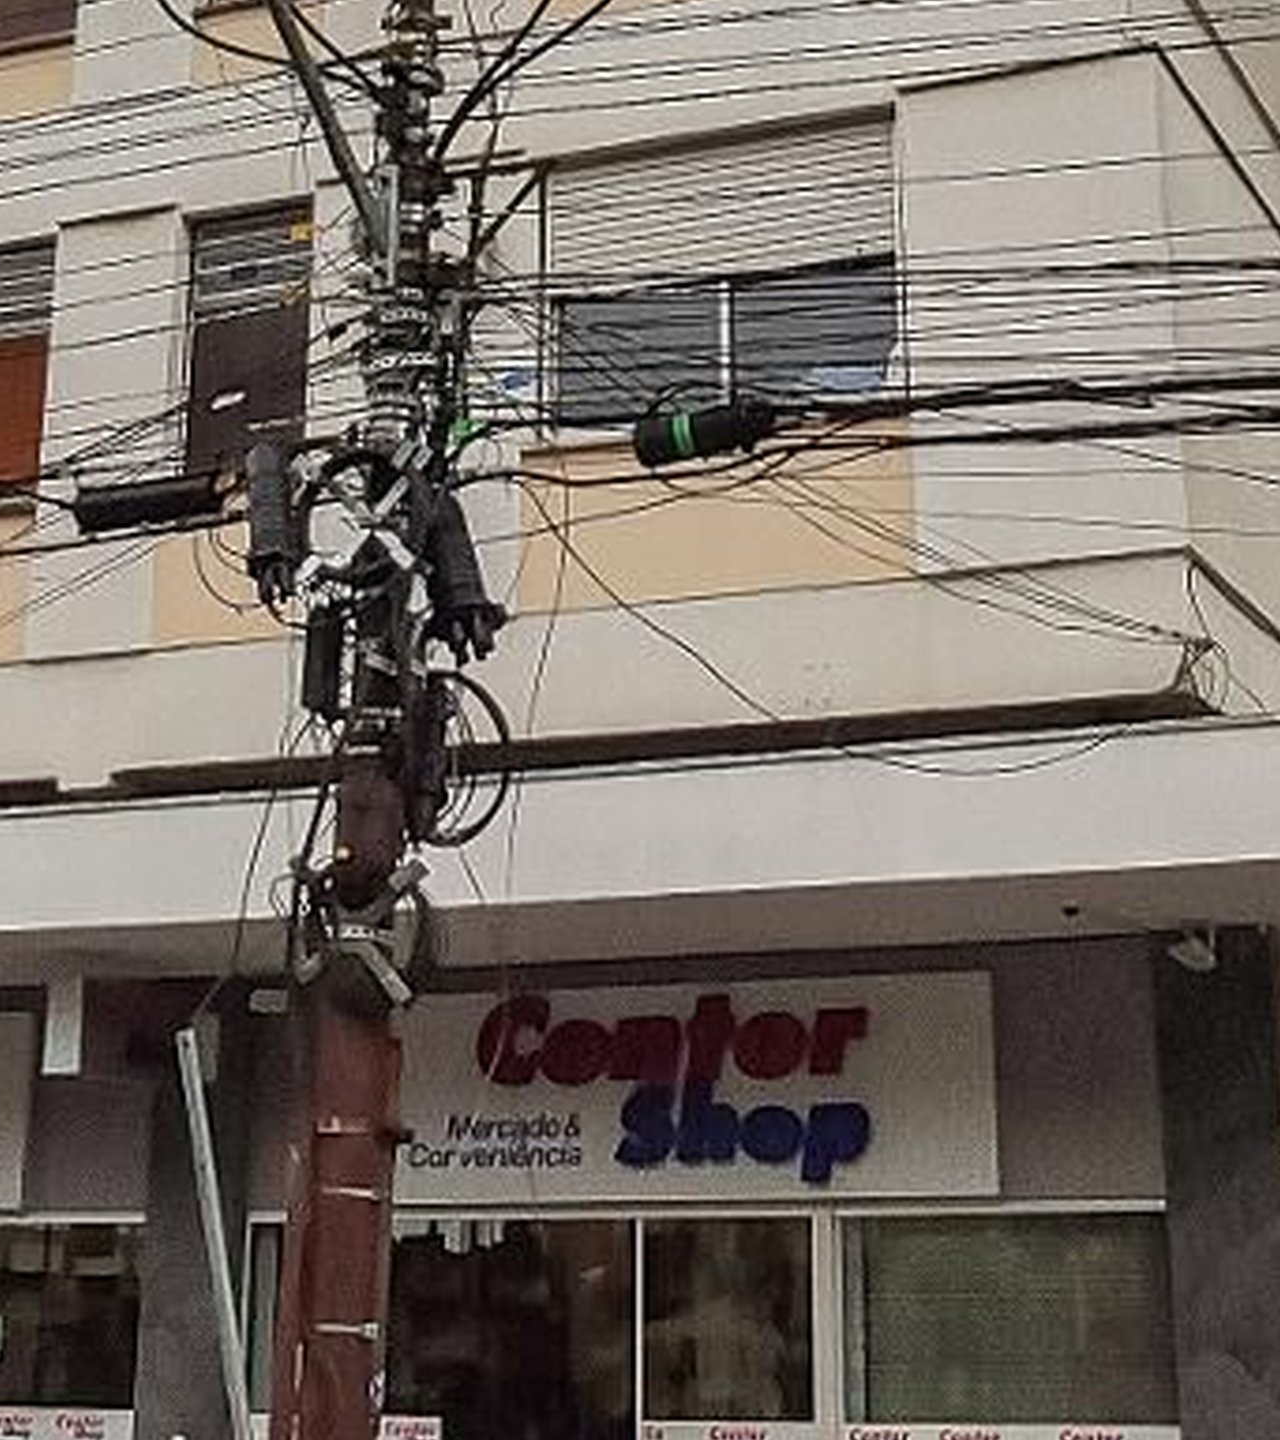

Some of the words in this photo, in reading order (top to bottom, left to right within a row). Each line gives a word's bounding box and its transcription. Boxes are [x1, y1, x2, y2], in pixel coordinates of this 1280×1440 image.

[477, 993, 869, 1086] Center
[447, 1113, 559, 1140] Mercado
[614, 1081, 872, 1186] Shop
